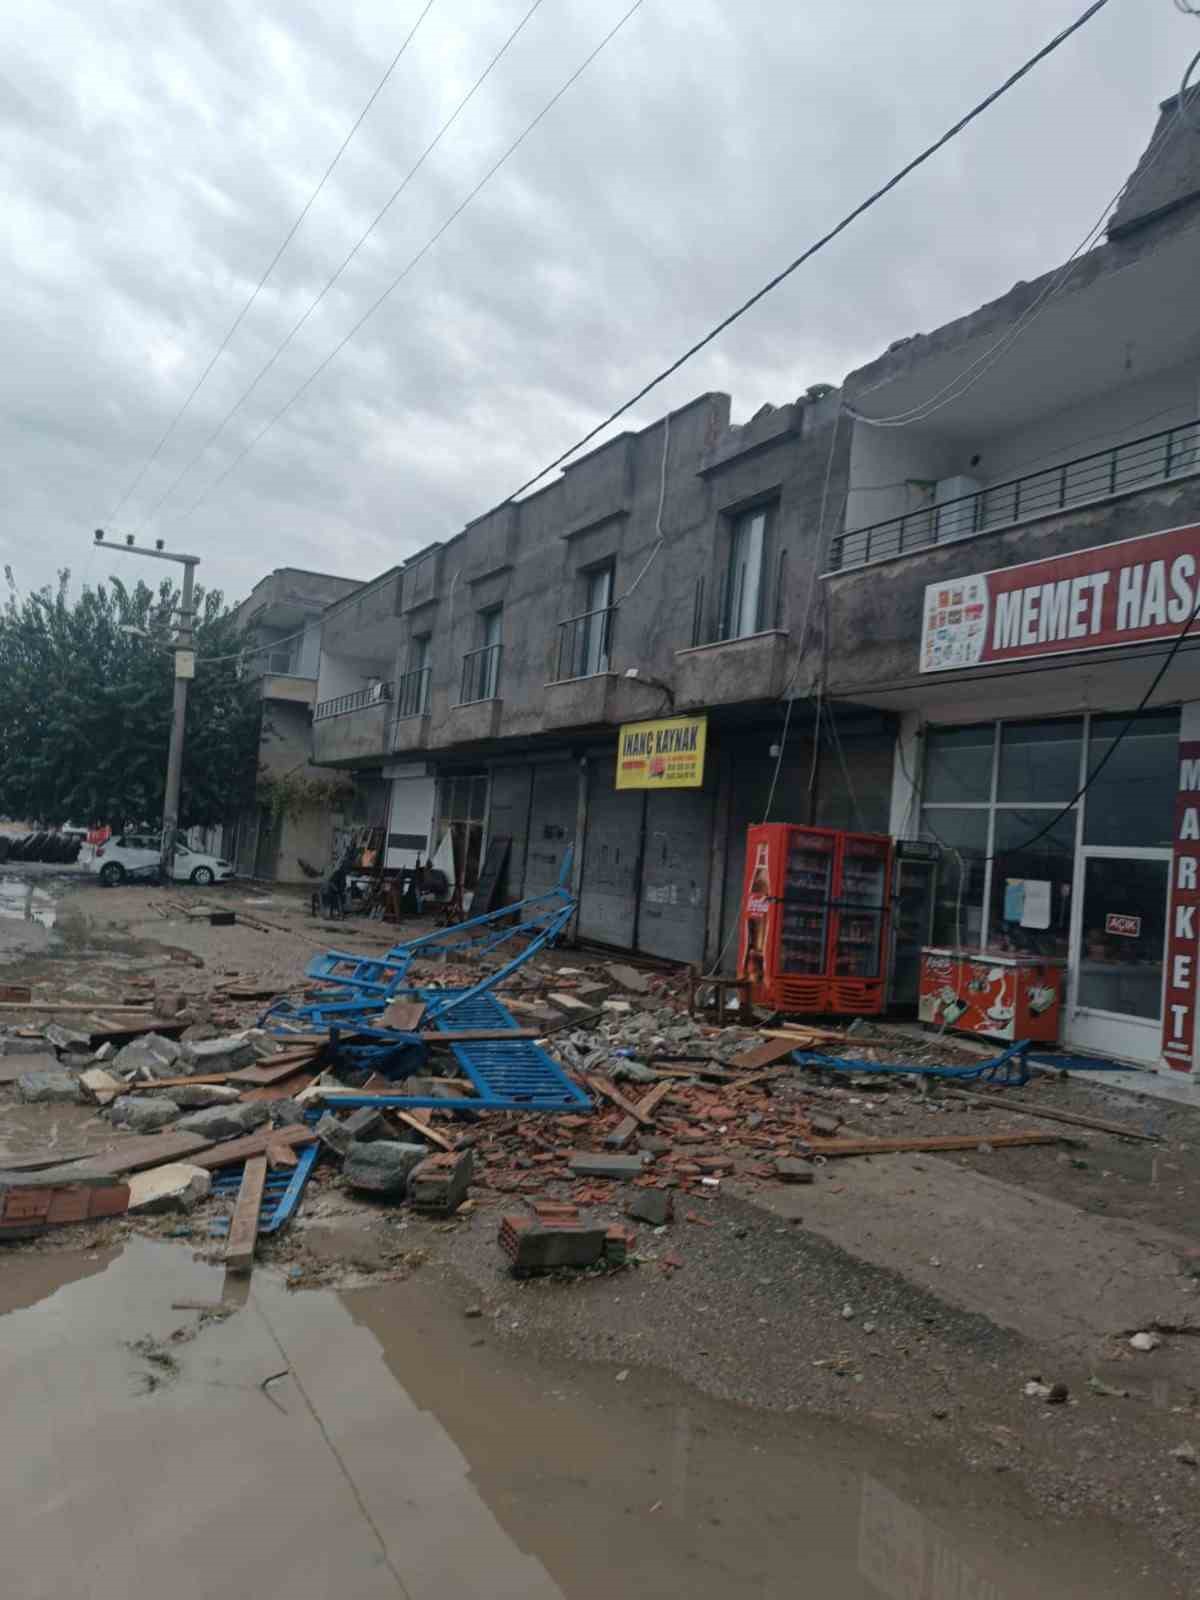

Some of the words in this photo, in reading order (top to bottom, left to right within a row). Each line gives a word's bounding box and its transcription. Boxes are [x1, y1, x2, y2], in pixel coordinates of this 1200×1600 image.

[993, 571, 1110, 650] MEMET
[1117, 553, 1200, 631] HAS
[656, 725, 699, 753] KAYNAK
[1170, 759, 1200, 1038] MARKET
